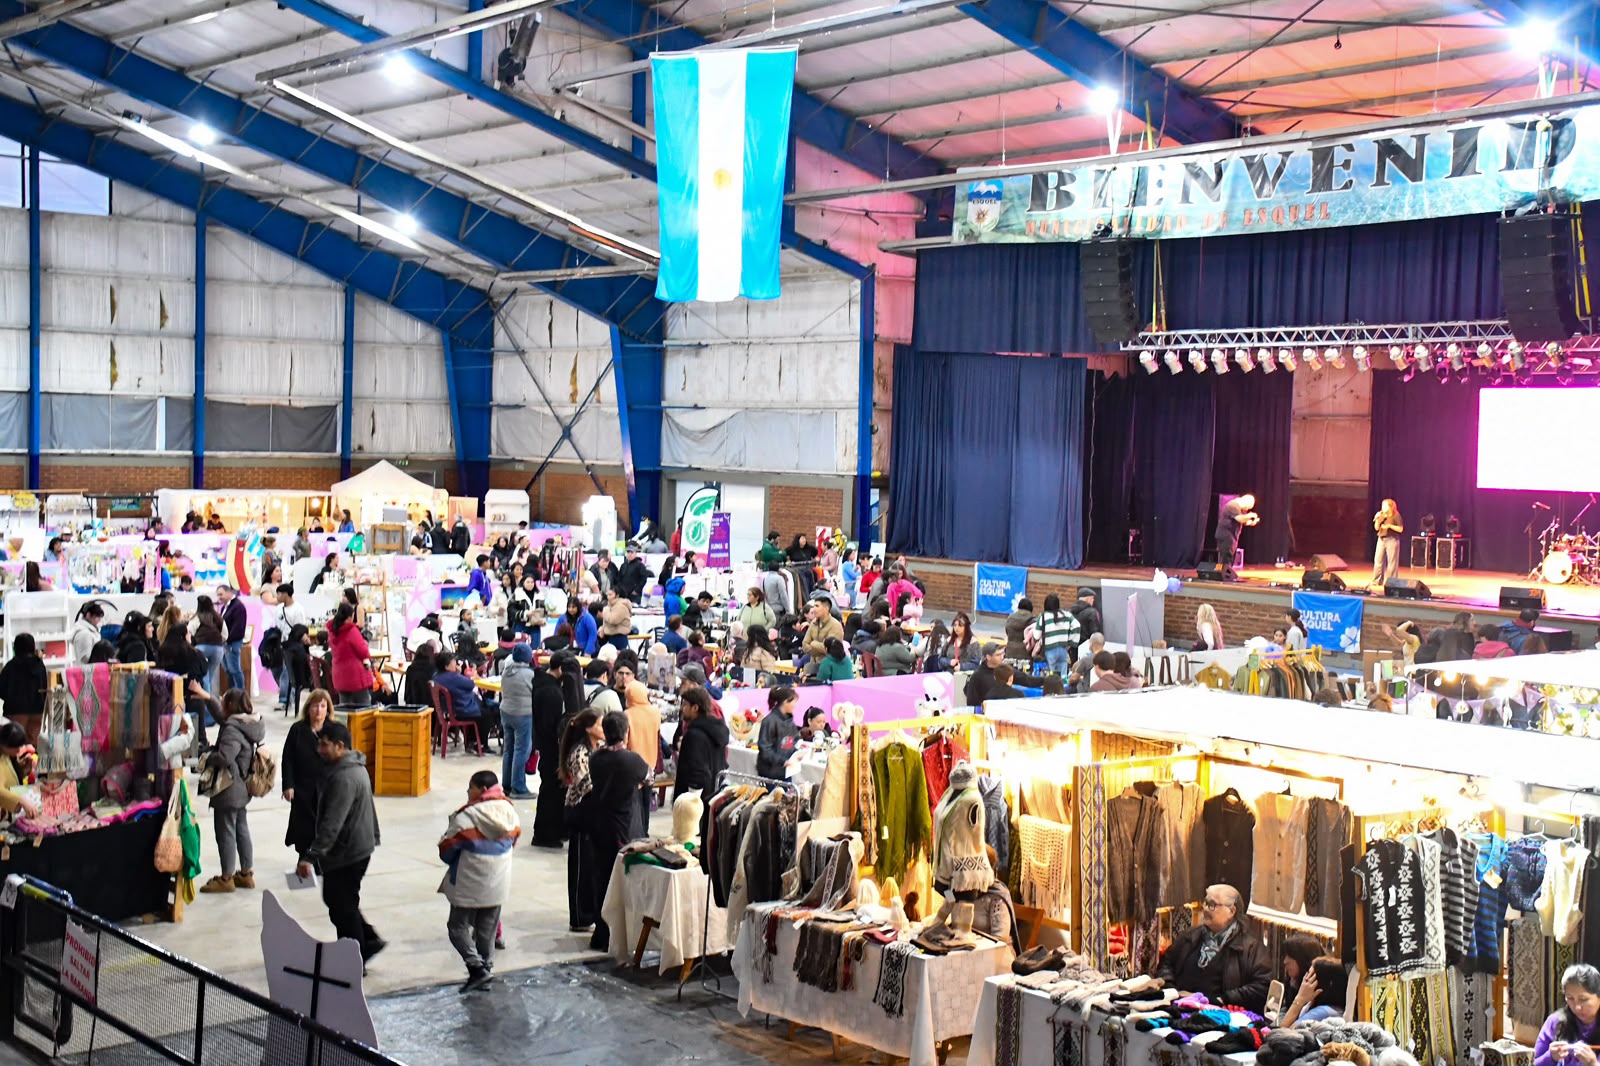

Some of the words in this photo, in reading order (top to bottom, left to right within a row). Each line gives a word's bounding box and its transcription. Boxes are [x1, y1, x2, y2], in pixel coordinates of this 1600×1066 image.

[1200, 211, 1228, 230] DE
[1243, 202, 1331, 227] ESQUEL
[979, 579, 1011, 591] CULTURA
[979, 587, 1006, 597] ESQUEL
[1299, 609, 1342, 623] CULTURA
[1302, 619, 1334, 632] SQUEL
[62, 967, 69, 978] LA
[70, 955, 90, 981] SALTAR
